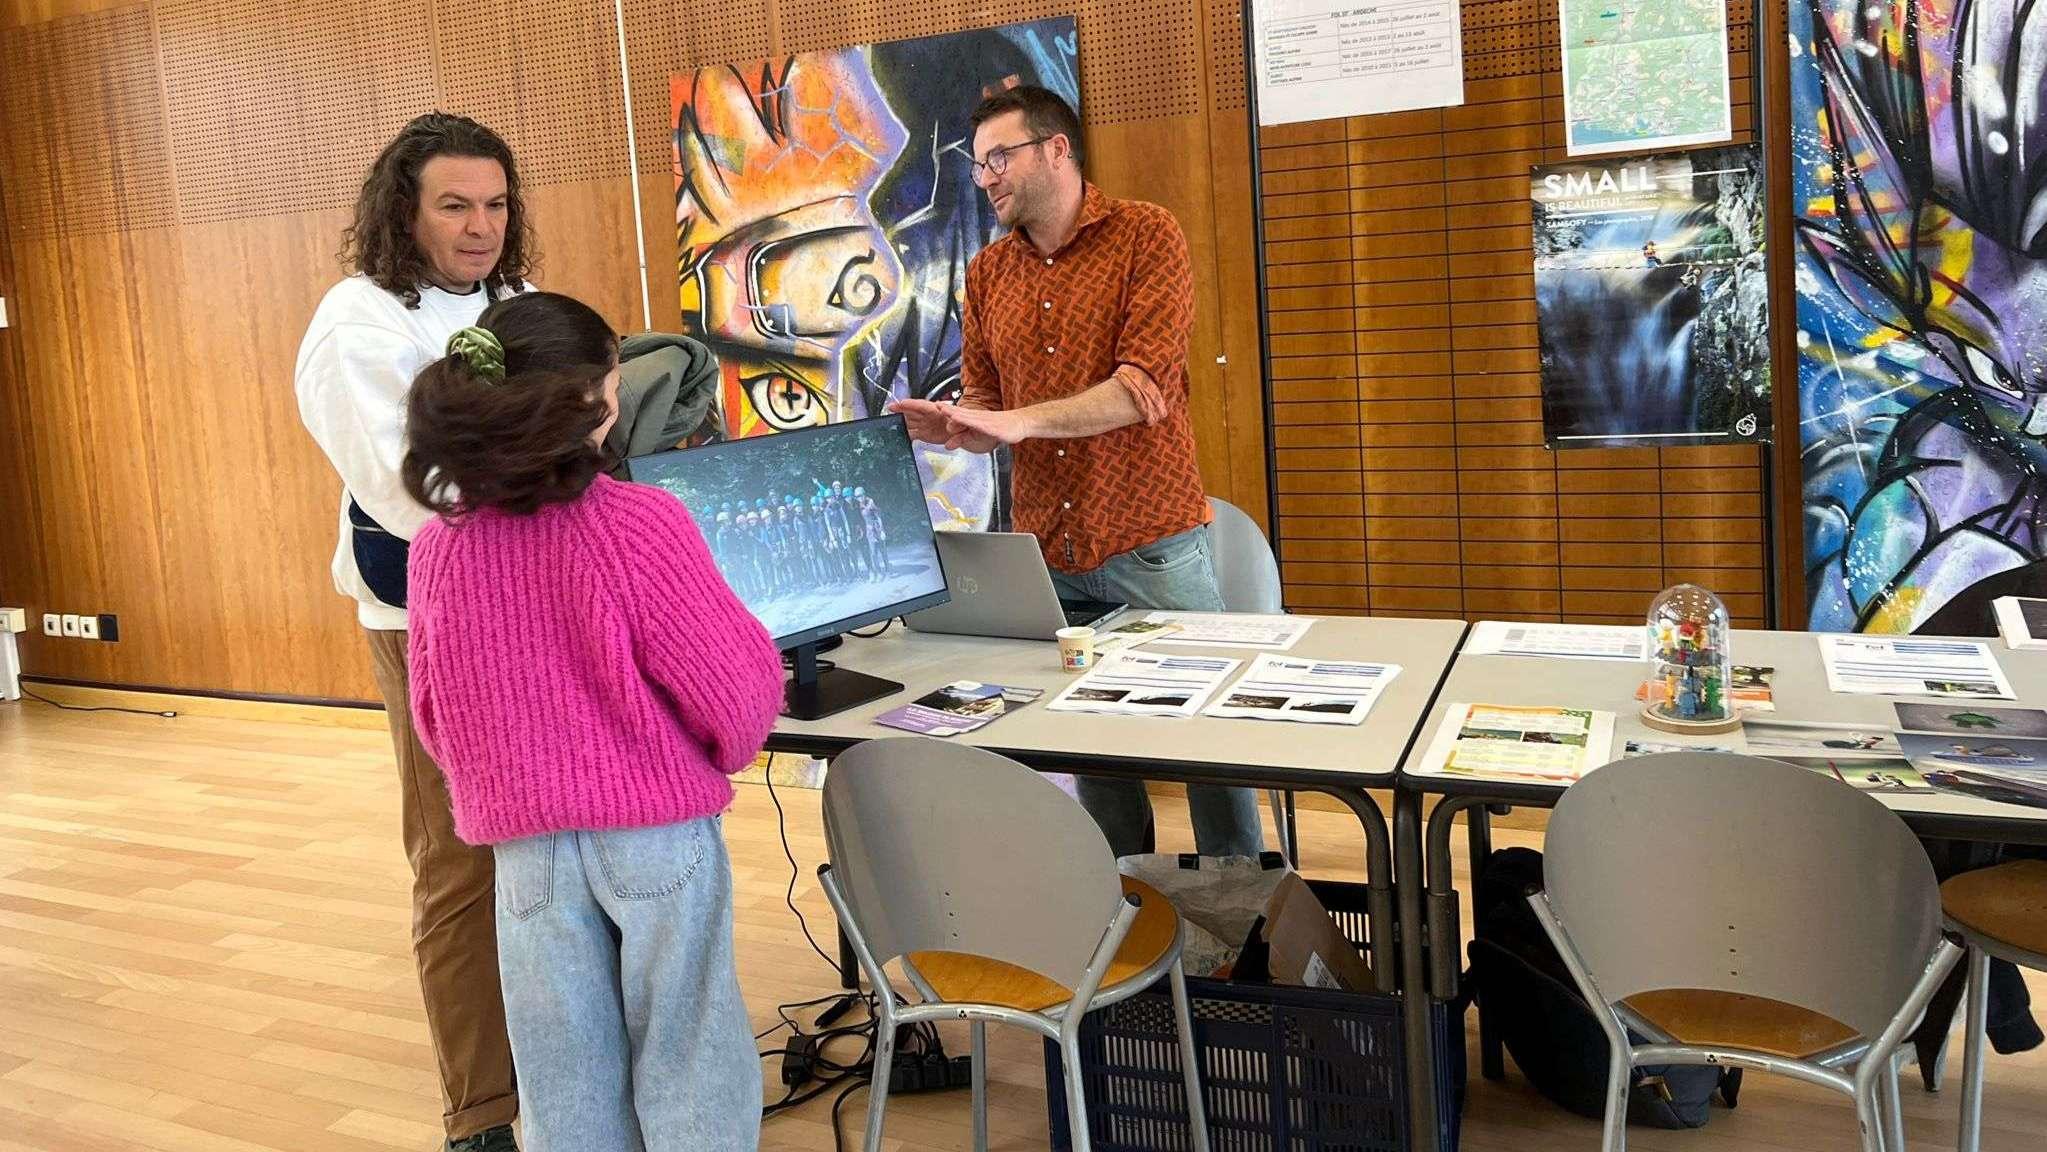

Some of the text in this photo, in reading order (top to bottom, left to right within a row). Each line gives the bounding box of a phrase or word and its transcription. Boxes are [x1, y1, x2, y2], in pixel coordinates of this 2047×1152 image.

[1544, 166, 1657, 199] SMALL
[1545, 202, 1557, 213] IS
[1558, 197, 1623, 210] BEAUTIFUL
